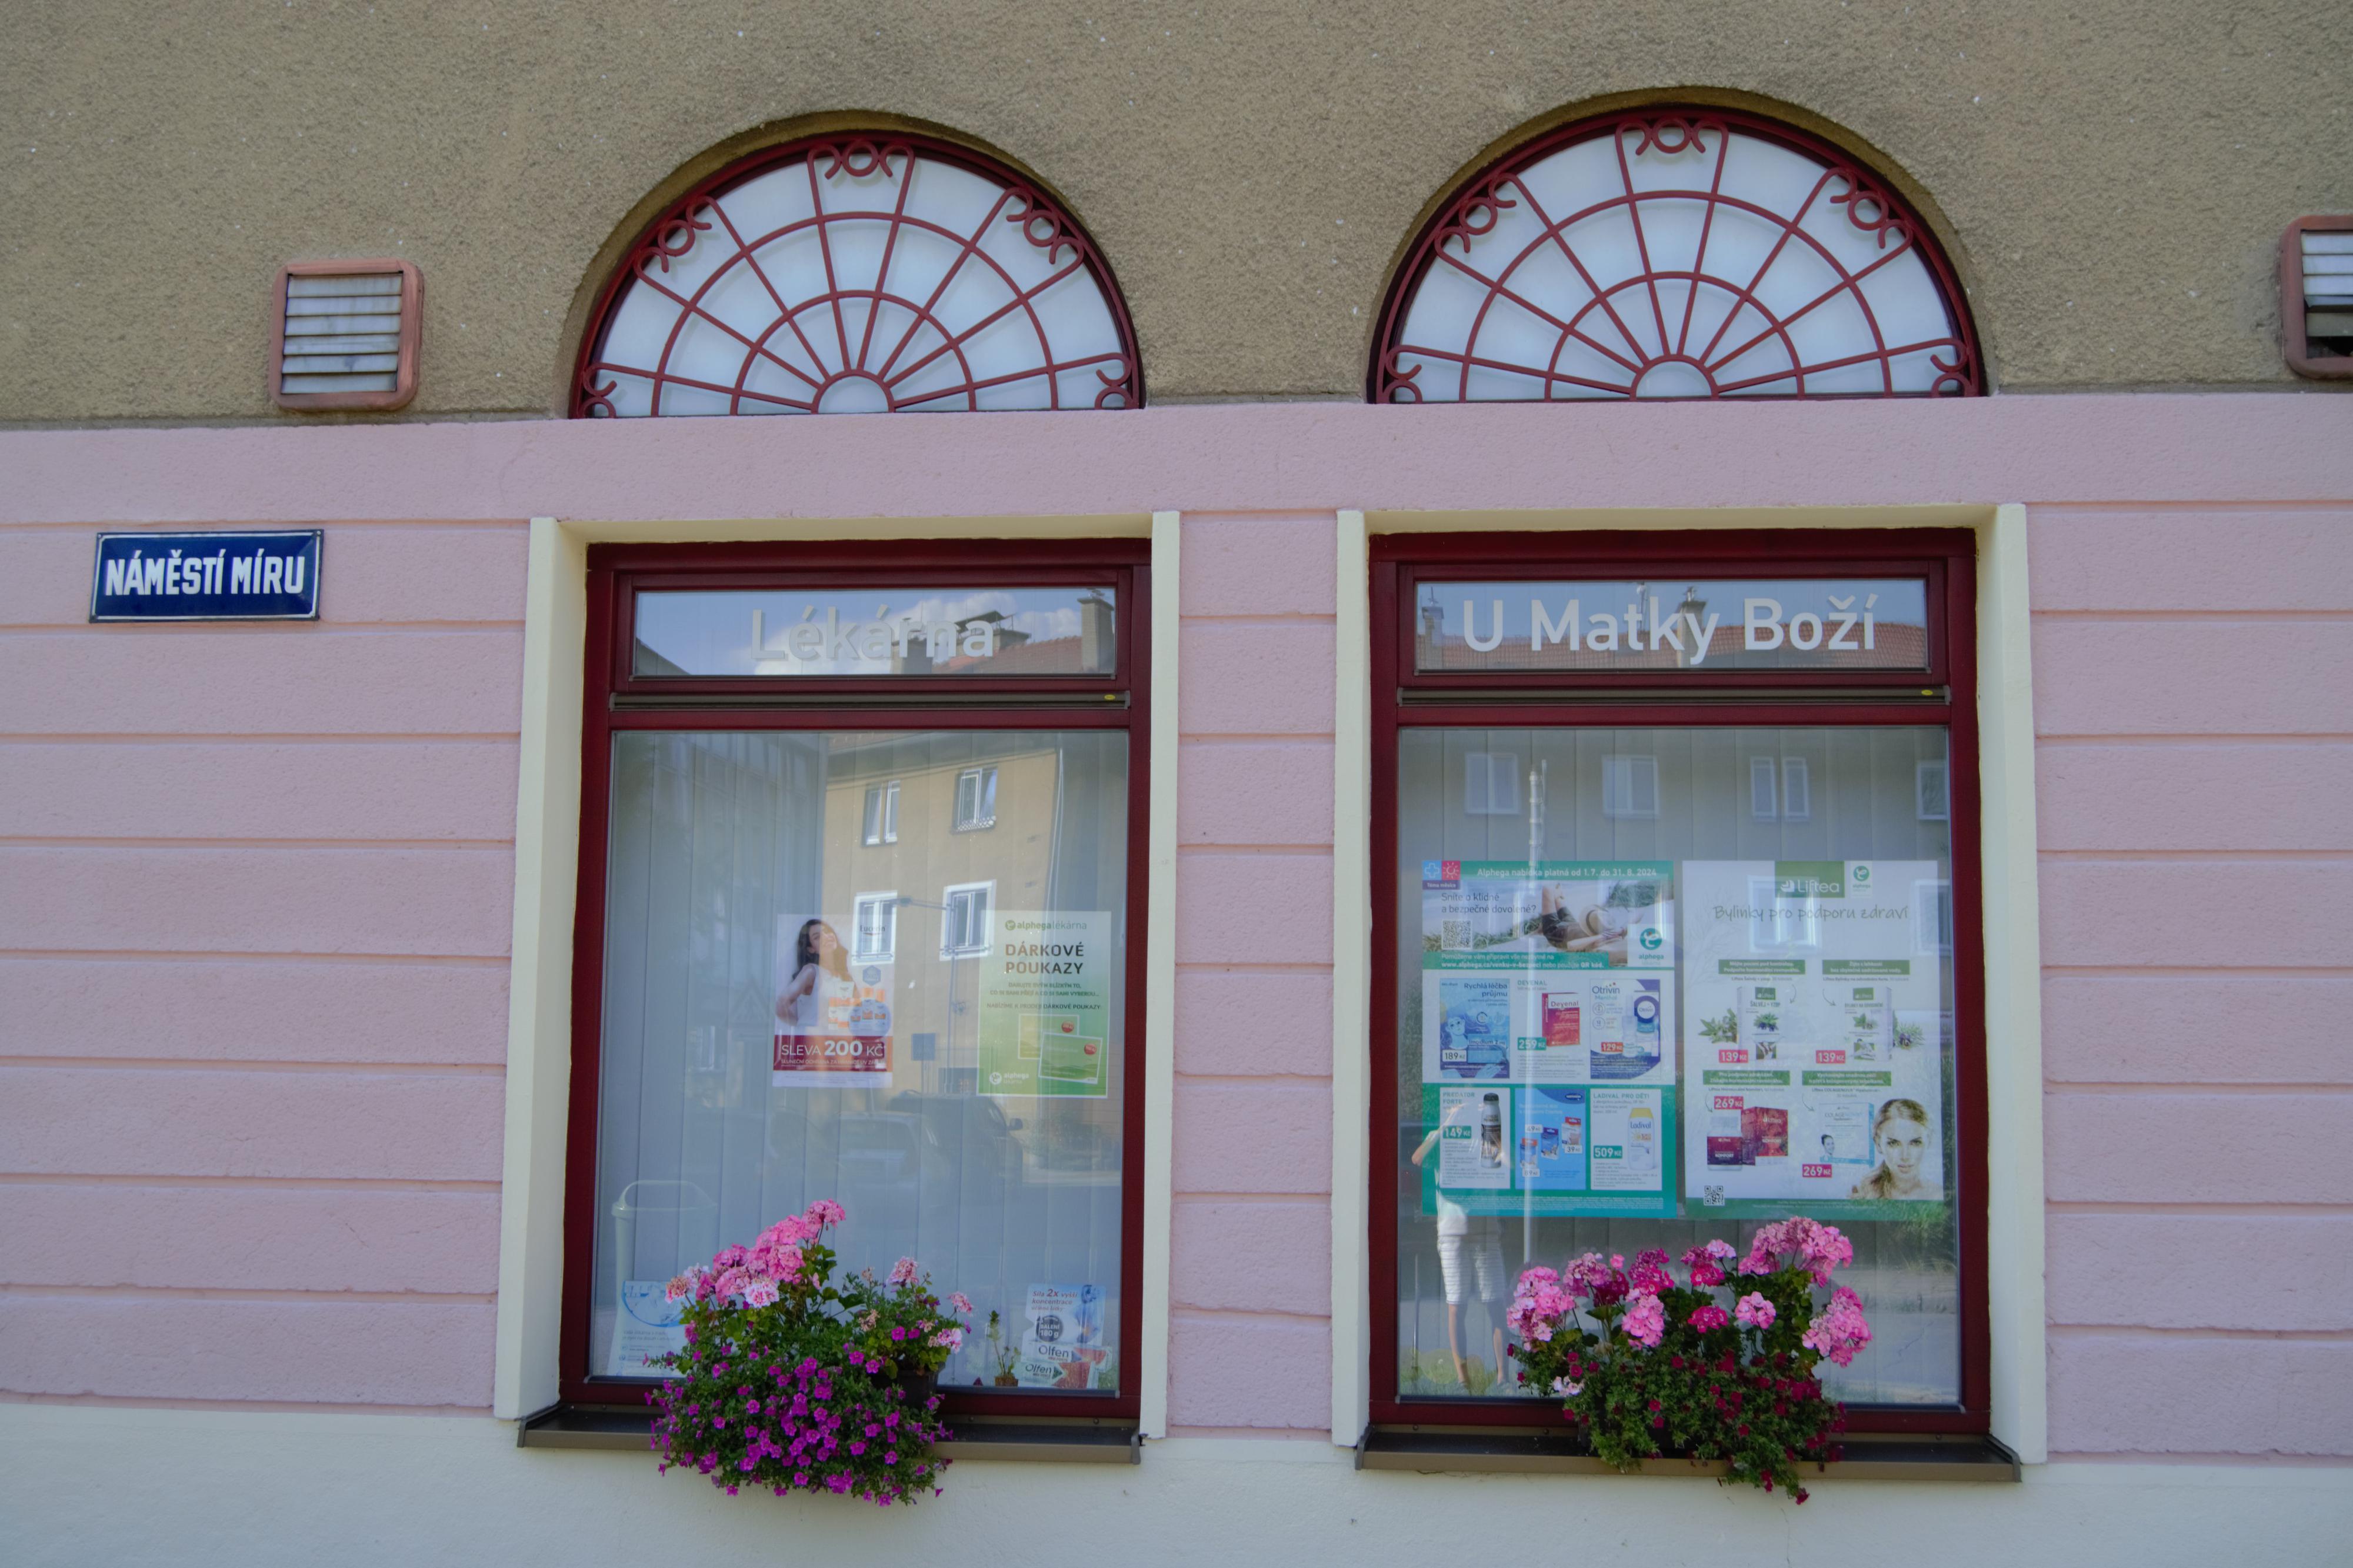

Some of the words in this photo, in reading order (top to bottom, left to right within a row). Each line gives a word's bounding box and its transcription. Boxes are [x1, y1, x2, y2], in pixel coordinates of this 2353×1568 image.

[105, 549, 226, 596] NÁMĚSTÍ
[231, 548, 305, 594] MÍRU
[750, 605, 994, 660] Lékárna
[1463, 599, 1503, 652] U
[1531, 596, 1719, 665] Matky
[1744, 593, 1879, 650] Boží
[1478, 868, 1509, 878] Alphega
[1544, 868, 1569, 878] platná
[1798, 879, 1839, 893] Liftea
[1474, 892, 1499, 901] klidné
[1449, 904, 1489, 915] bezpečné
[1713, 905, 1764, 922] Bylinky
[1769, 908, 1792, 921] pro
[1798, 906, 1856, 922] podporu
[1861, 905, 1909, 919] zdraví
[1017, 921, 1051, 930] alphega
[1005, 940, 1085, 957] DÁRKOVÉ
[1005, 961, 1084, 975] POUKAZY
[1592, 985, 1620, 995] Otrivin
[781, 1045, 821, 1056] SLEVA
[824, 1040, 863, 1056] 200
[1518, 1039, 1537, 1049] 259
[1721, 1052, 1739, 1061] 139
[1818, 1052, 1835, 1062] 139
[1715, 1099, 1734, 1108] 269
[1630, 1121, 1652, 1129] Ladival
[1445, 1127, 1462, 1137] 149
[1595, 1147, 1613, 1158] 509
[1804, 1166, 1822, 1176] 269
[1046, 1289, 1059, 1297] 2x
[1038, 1345, 1069, 1358] Olfen
[1025, 1363, 1052, 1374] Olfen
